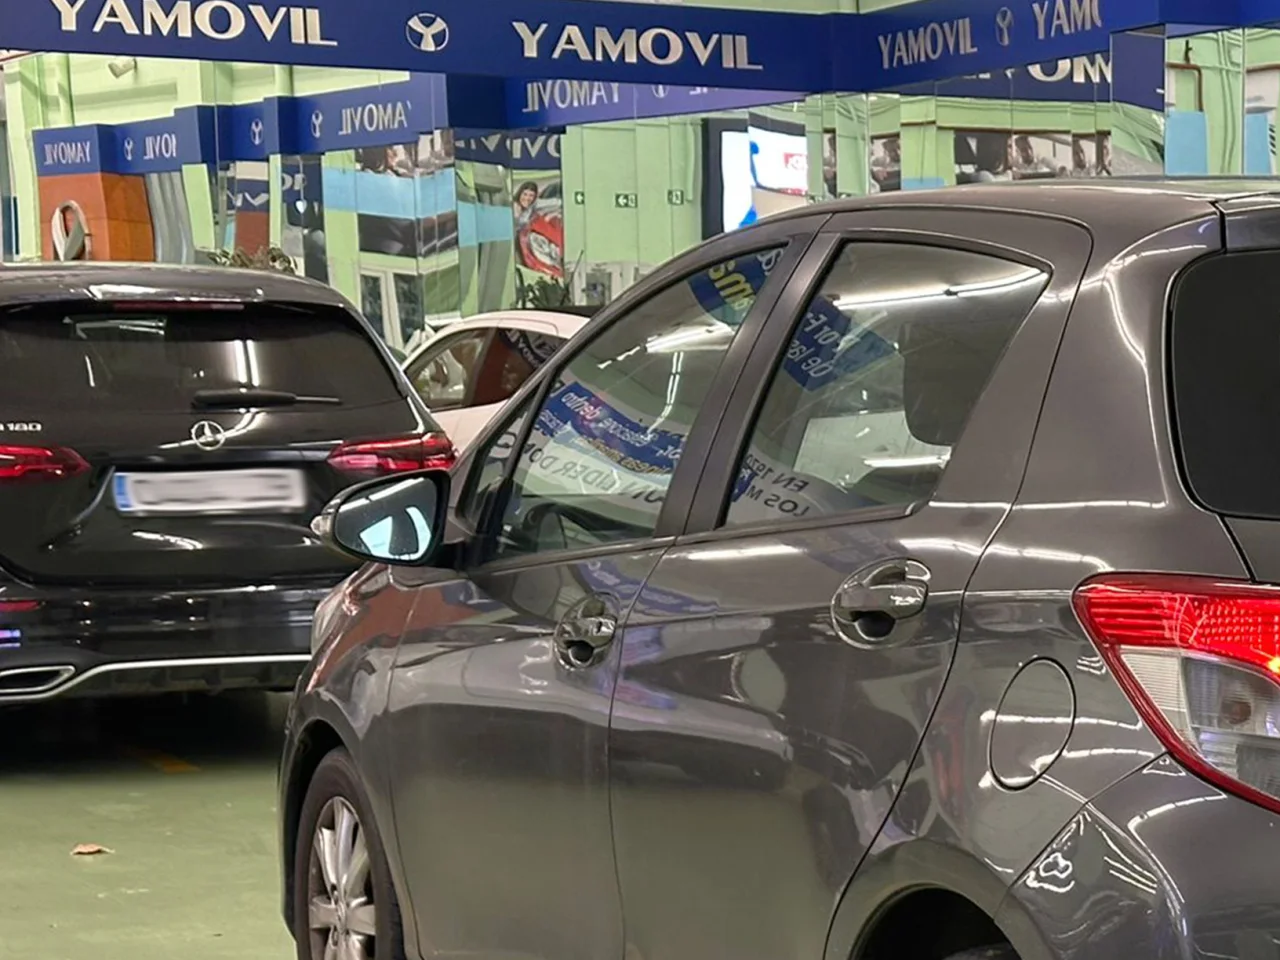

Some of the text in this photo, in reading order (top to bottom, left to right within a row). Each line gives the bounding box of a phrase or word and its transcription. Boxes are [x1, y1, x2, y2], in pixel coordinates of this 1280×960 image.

[51, 0, 763, 70] YAMOVIL YAMOVIL
[877, 18, 978, 69] YAMOVIL
